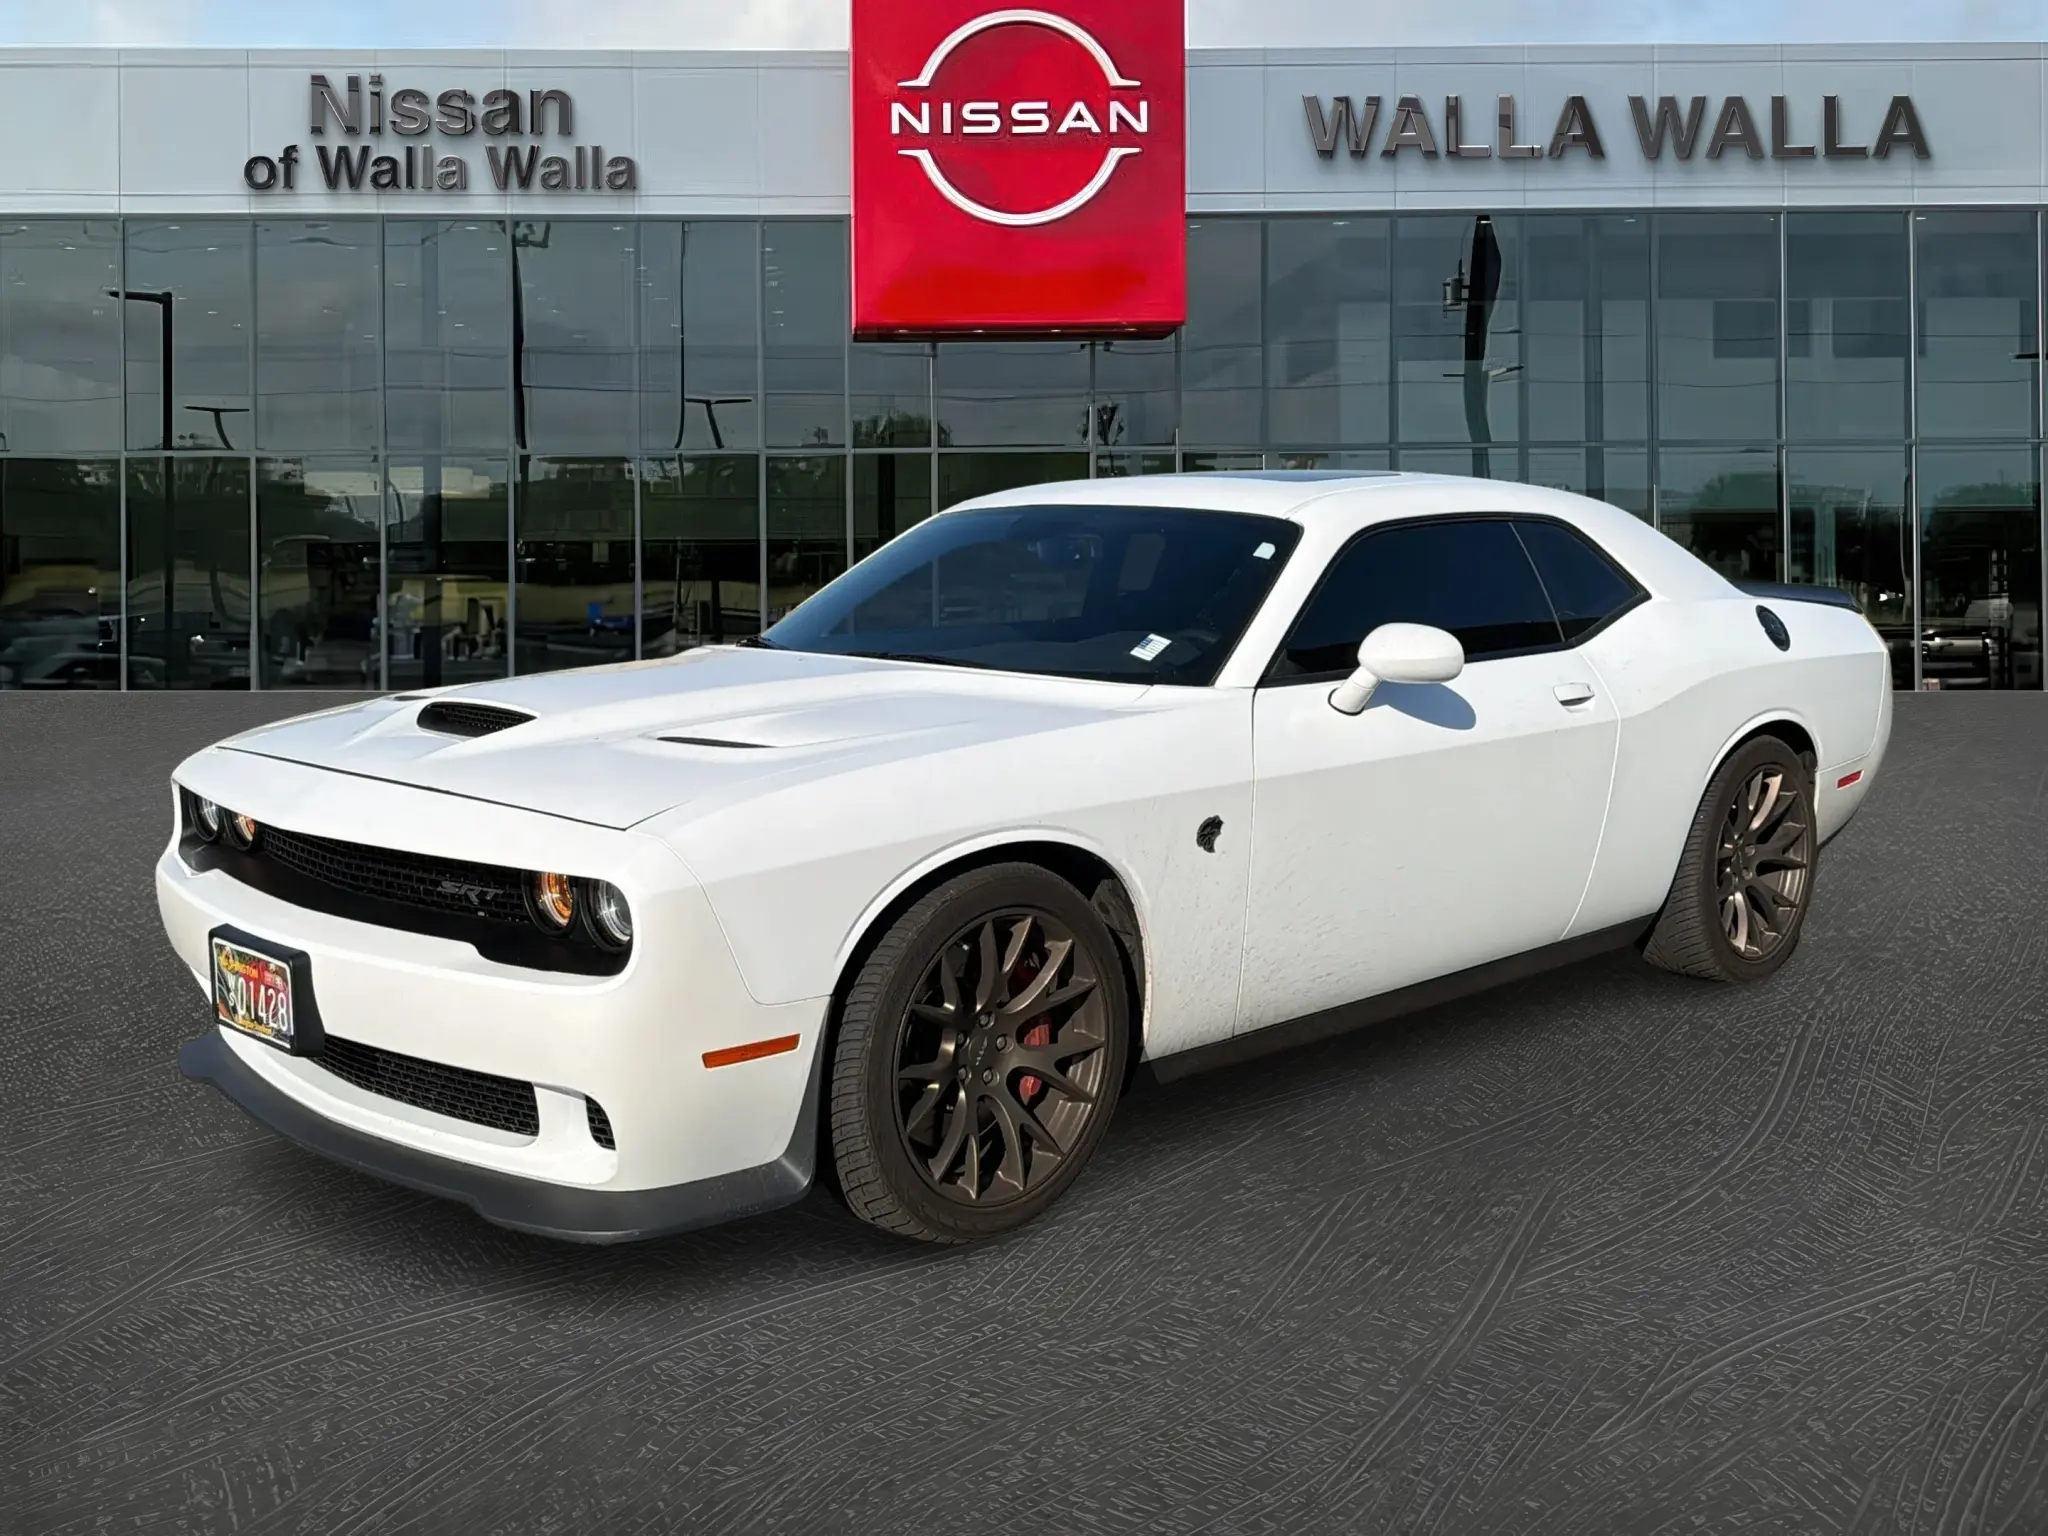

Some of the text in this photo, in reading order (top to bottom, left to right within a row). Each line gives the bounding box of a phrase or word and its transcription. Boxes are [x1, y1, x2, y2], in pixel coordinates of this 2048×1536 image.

[310, 73, 572, 136] Nissan
[890, 100, 1148, 134] NISSAN
[1302, 93, 1932, 160] WALLA WALLA
[243, 144, 637, 190] of Walla Walla
